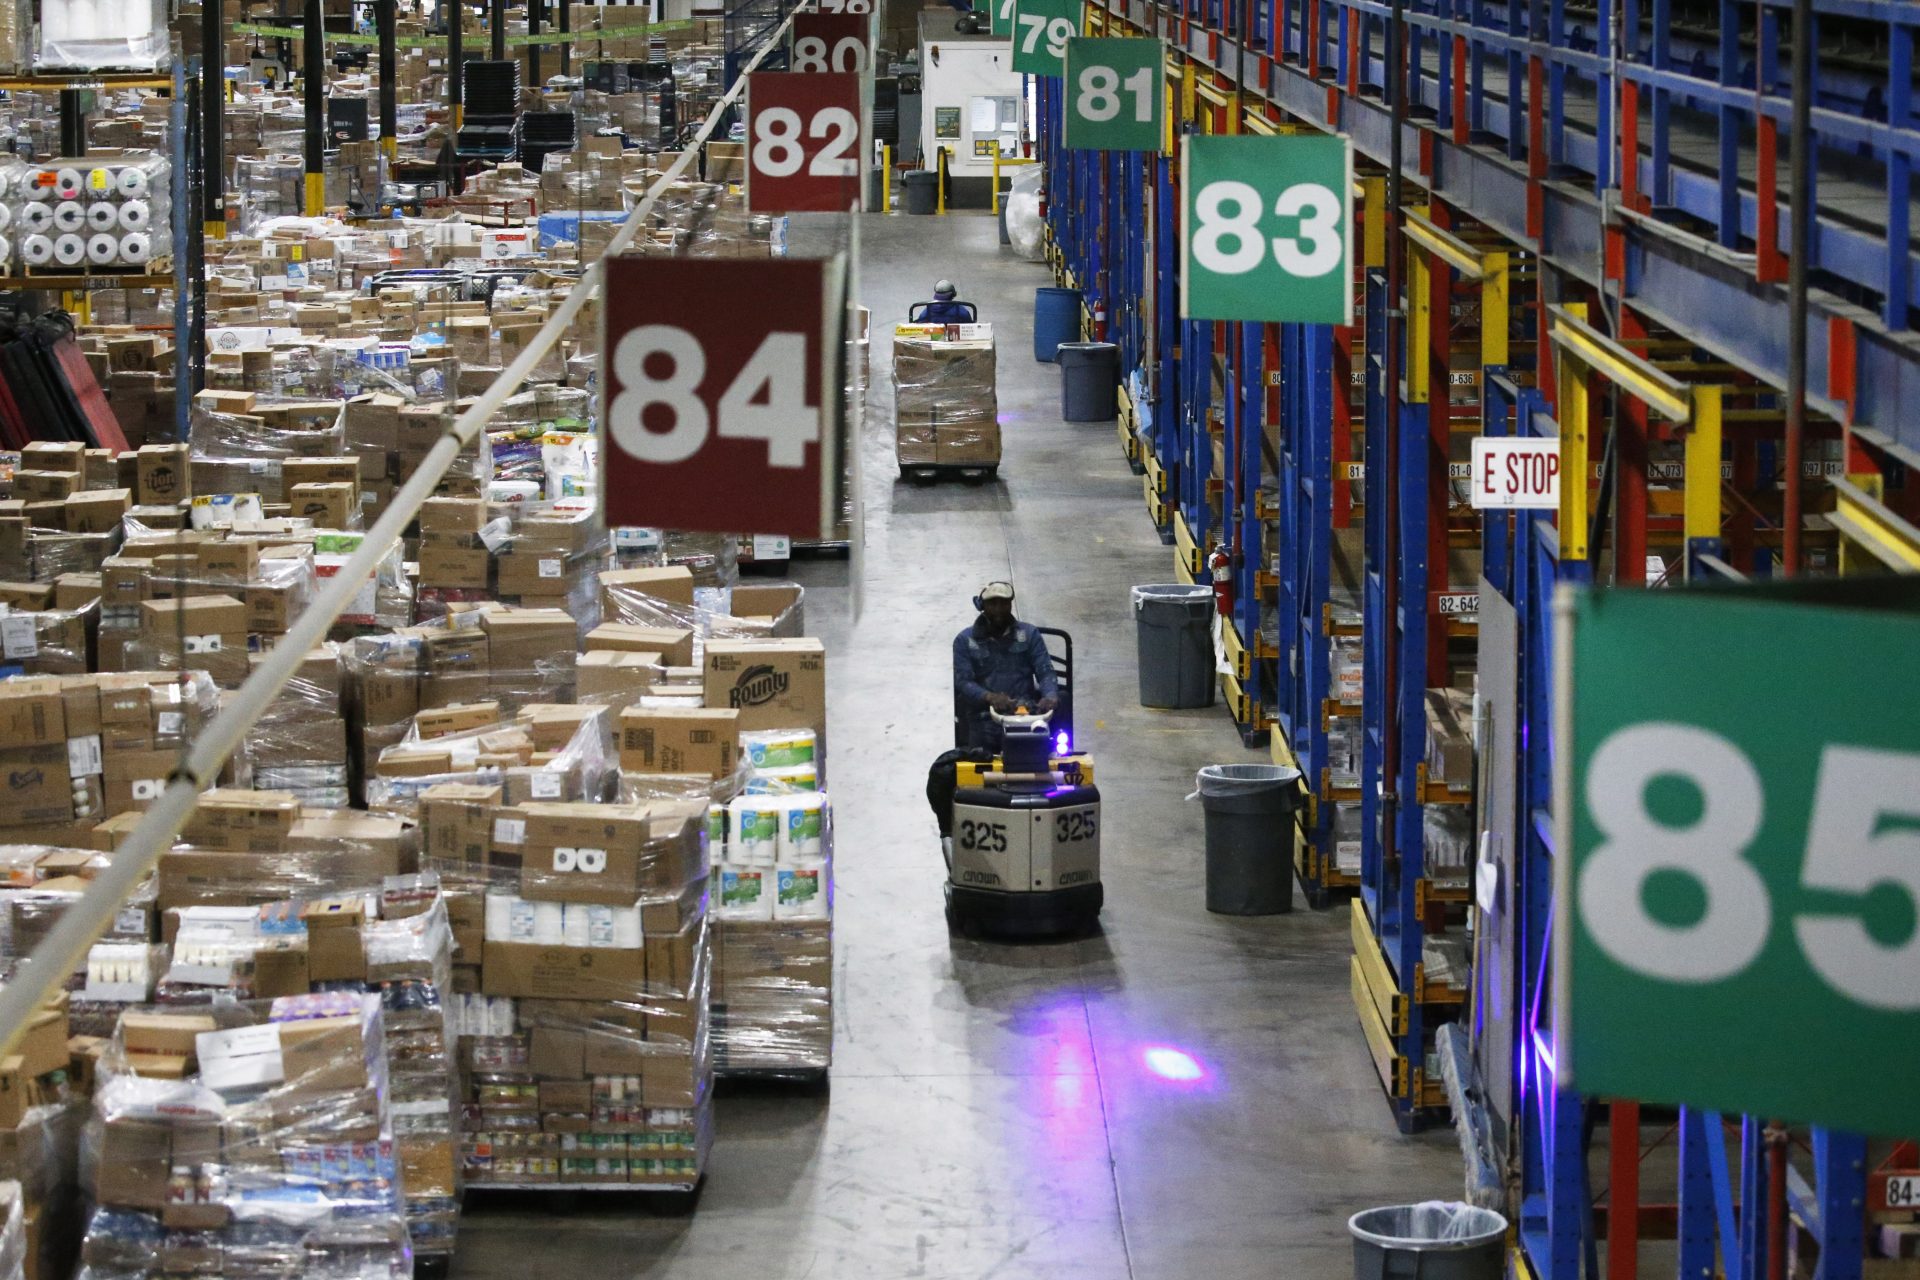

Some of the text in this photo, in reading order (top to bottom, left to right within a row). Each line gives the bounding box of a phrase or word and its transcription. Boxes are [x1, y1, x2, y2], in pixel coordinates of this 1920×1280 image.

[1018, 13, 1076, 57] 79
[794, 36, 866, 73] 80
[1076, 65, 1153, 122] 81
[752, 106, 858, 177] 82
[1192, 181, 1342, 277] 83
[609, 324, 819, 468] 84
[1484, 452, 1559, 494] E STOP
[1440, 596, 1479, 612] 82-642
[711, 655, 719, 671] 4
[729, 671, 790, 708] Bounty
[961, 820, 1008, 853] 325
[1056, 810, 1096, 843] 325
[963, 870, 1001, 885] CROWN
[1059, 869, 1093, 885] CROWN
[1577, 721, 1920, 1012] 85
